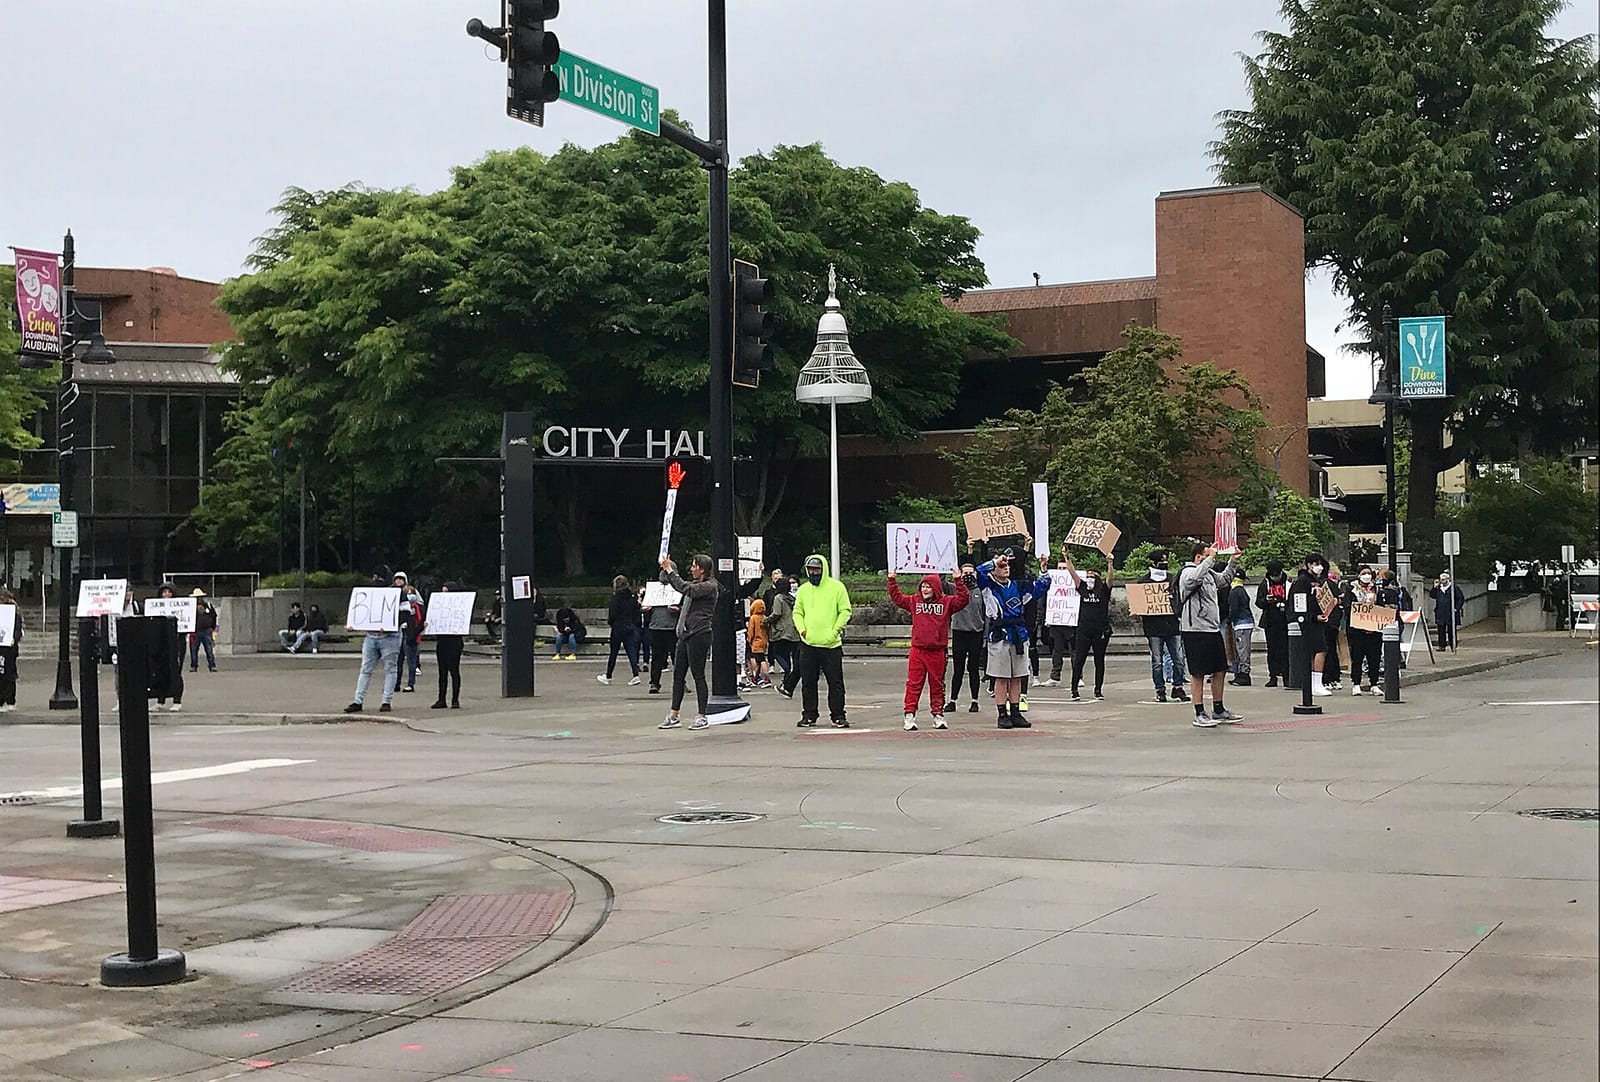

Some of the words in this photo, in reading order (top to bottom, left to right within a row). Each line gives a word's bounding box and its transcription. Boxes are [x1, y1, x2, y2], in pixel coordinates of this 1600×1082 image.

[558, 64, 568, 93] N
[573, 63, 636, 119] Division
[641, 98, 653, 125] St
[27, 311, 56, 336] Enjoy
[25, 331, 59, 342] DOWNTOWN
[24, 339, 59, 353] AUBURN
[1408, 366, 1438, 382] Dine
[1403, 387, 1443, 395] AUBURN
[542, 425, 630, 458] CITY
[646, 429, 712, 460] HAL
[55, 513, 61, 523] 2
[981, 506, 1013, 518] BLACK
[982, 514, 1016, 527] LIVES
[1074, 517, 1109, 531] BLACK
[985, 523, 1018, 537] MATTER
[1070, 525, 1105, 540] LIVES
[1066, 534, 1099, 547] MATTER
[895, 527, 957, 570] BLM
[431, 594, 469, 610] BLACK
[1048, 598, 1074, 609] UNTIL
[1145, 595, 1170, 604] LIVE
[352, 591, 397, 627] BLM
[440, 607, 466, 619] LIVES
[1352, 603, 1374, 614] STOP
[1052, 612, 1077, 624] BLM
[1359, 613, 1395, 625] KILLING
[428, 619, 466, 633] MATTER
